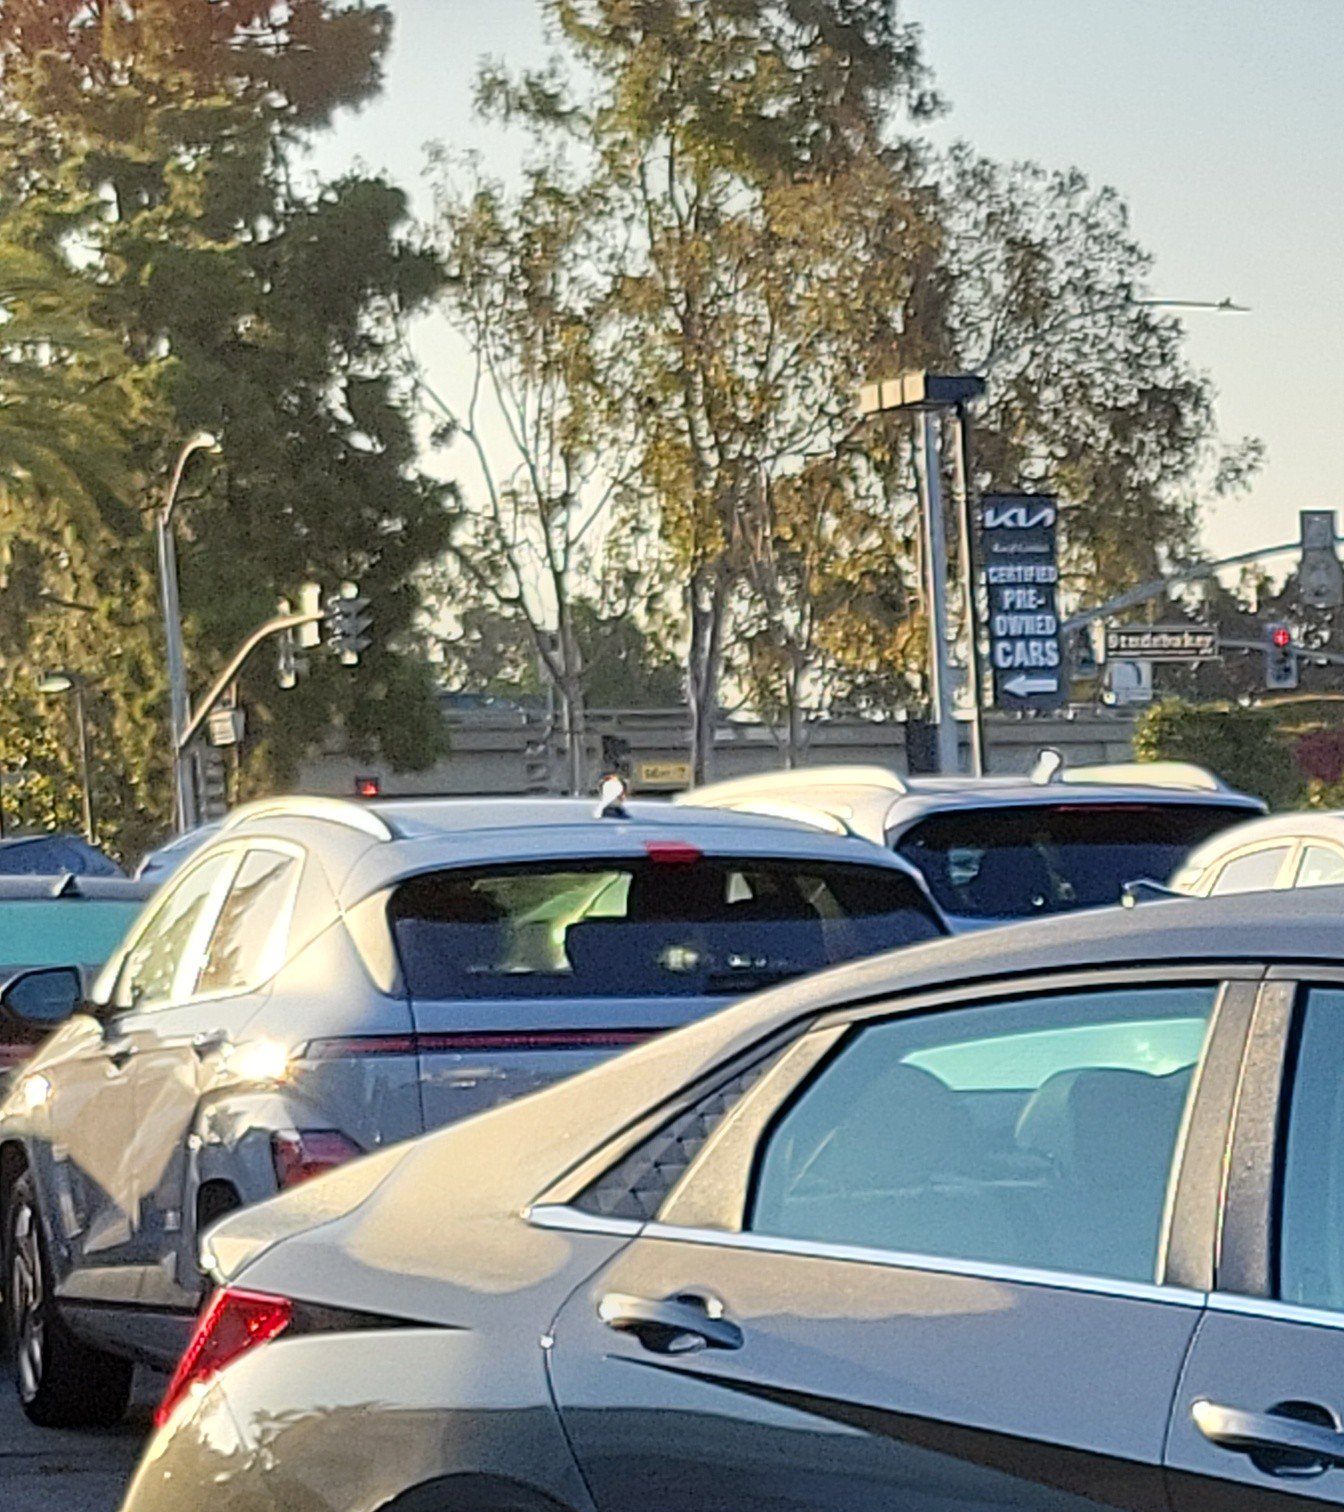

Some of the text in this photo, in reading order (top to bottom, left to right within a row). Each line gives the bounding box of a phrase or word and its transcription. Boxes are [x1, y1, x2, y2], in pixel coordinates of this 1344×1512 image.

[984, 507, 1056, 529] KIA
[988, 565, 1058, 584] CERTIFIED
[1002, 589, 1046, 611] PRE-
[995, 615, 1057, 637] OWNED
[994, 640, 1060, 668] CARS
